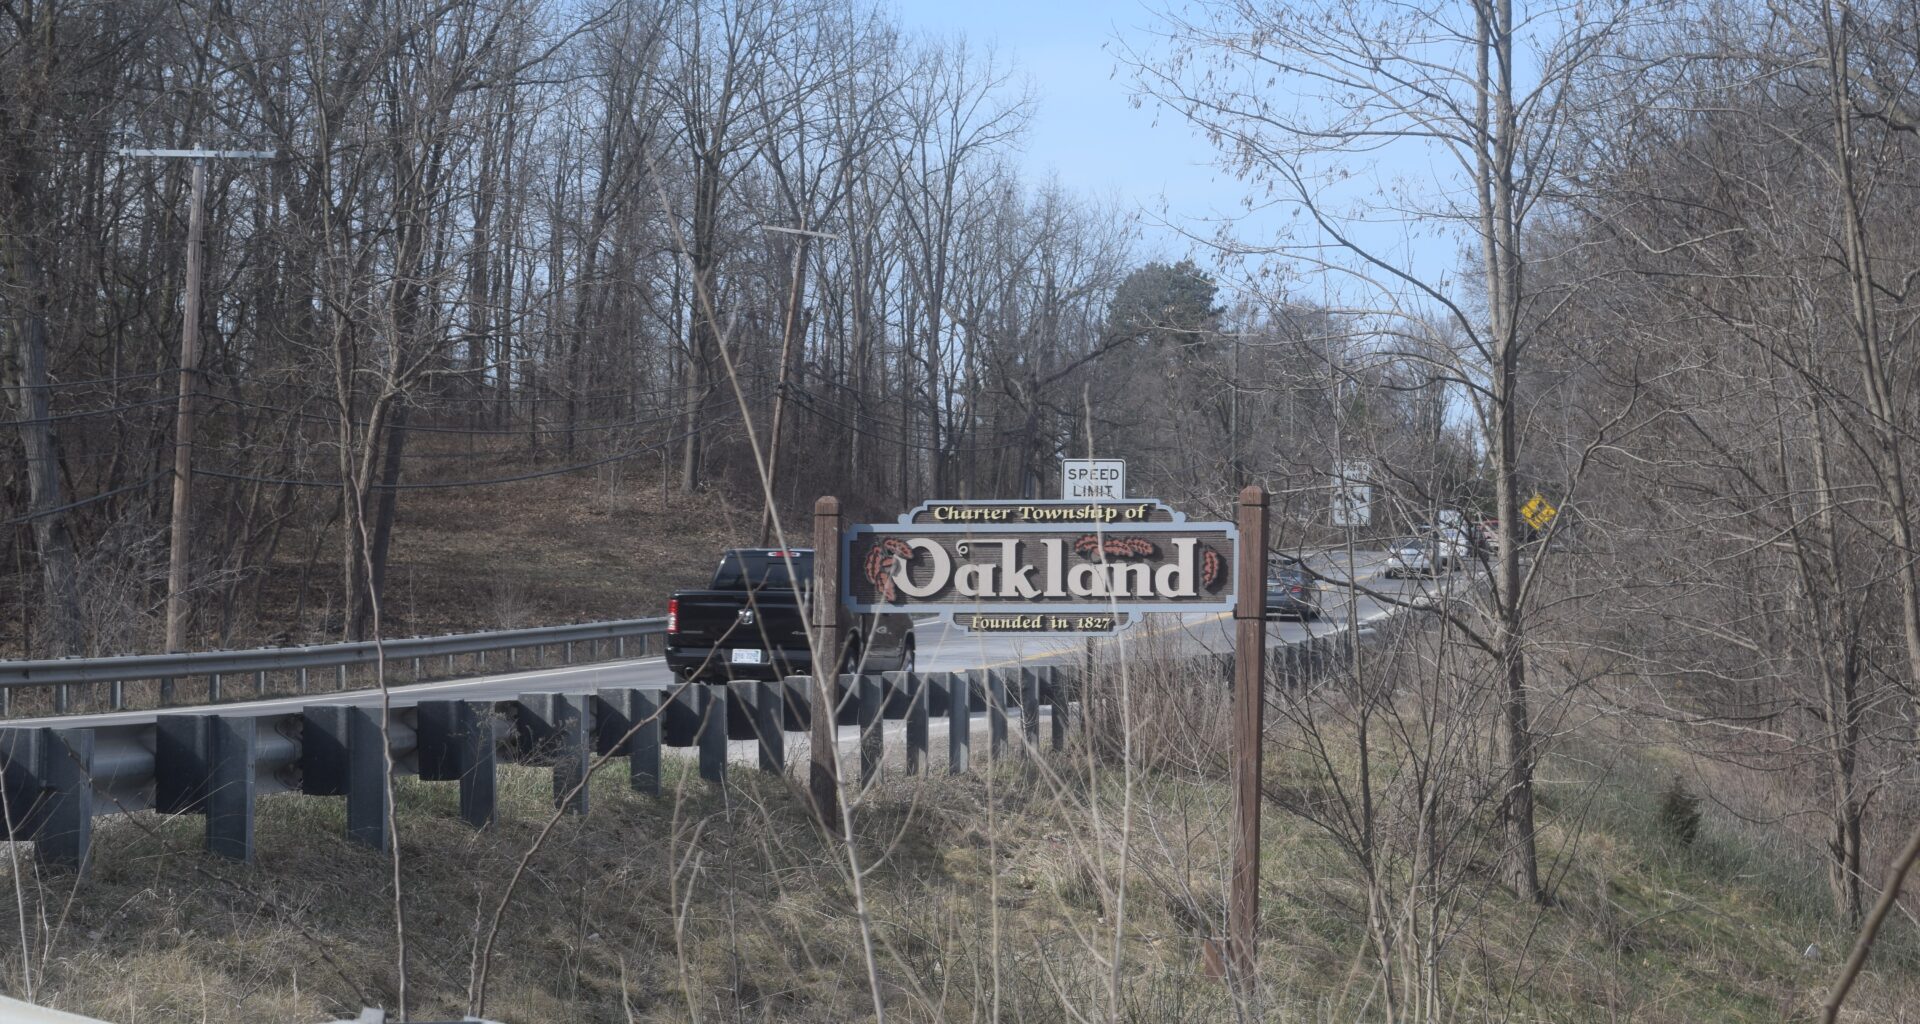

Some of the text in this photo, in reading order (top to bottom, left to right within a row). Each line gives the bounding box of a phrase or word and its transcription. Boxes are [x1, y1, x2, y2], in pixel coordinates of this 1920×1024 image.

[1068, 468, 1119, 480] SPEED
[1073, 485, 1113, 497] LIMIT
[934, 503, 1148, 523] Charter Township of
[892, 537, 1198, 598] Oakland
[972, 615, 1111, 630] Founded in 1827
